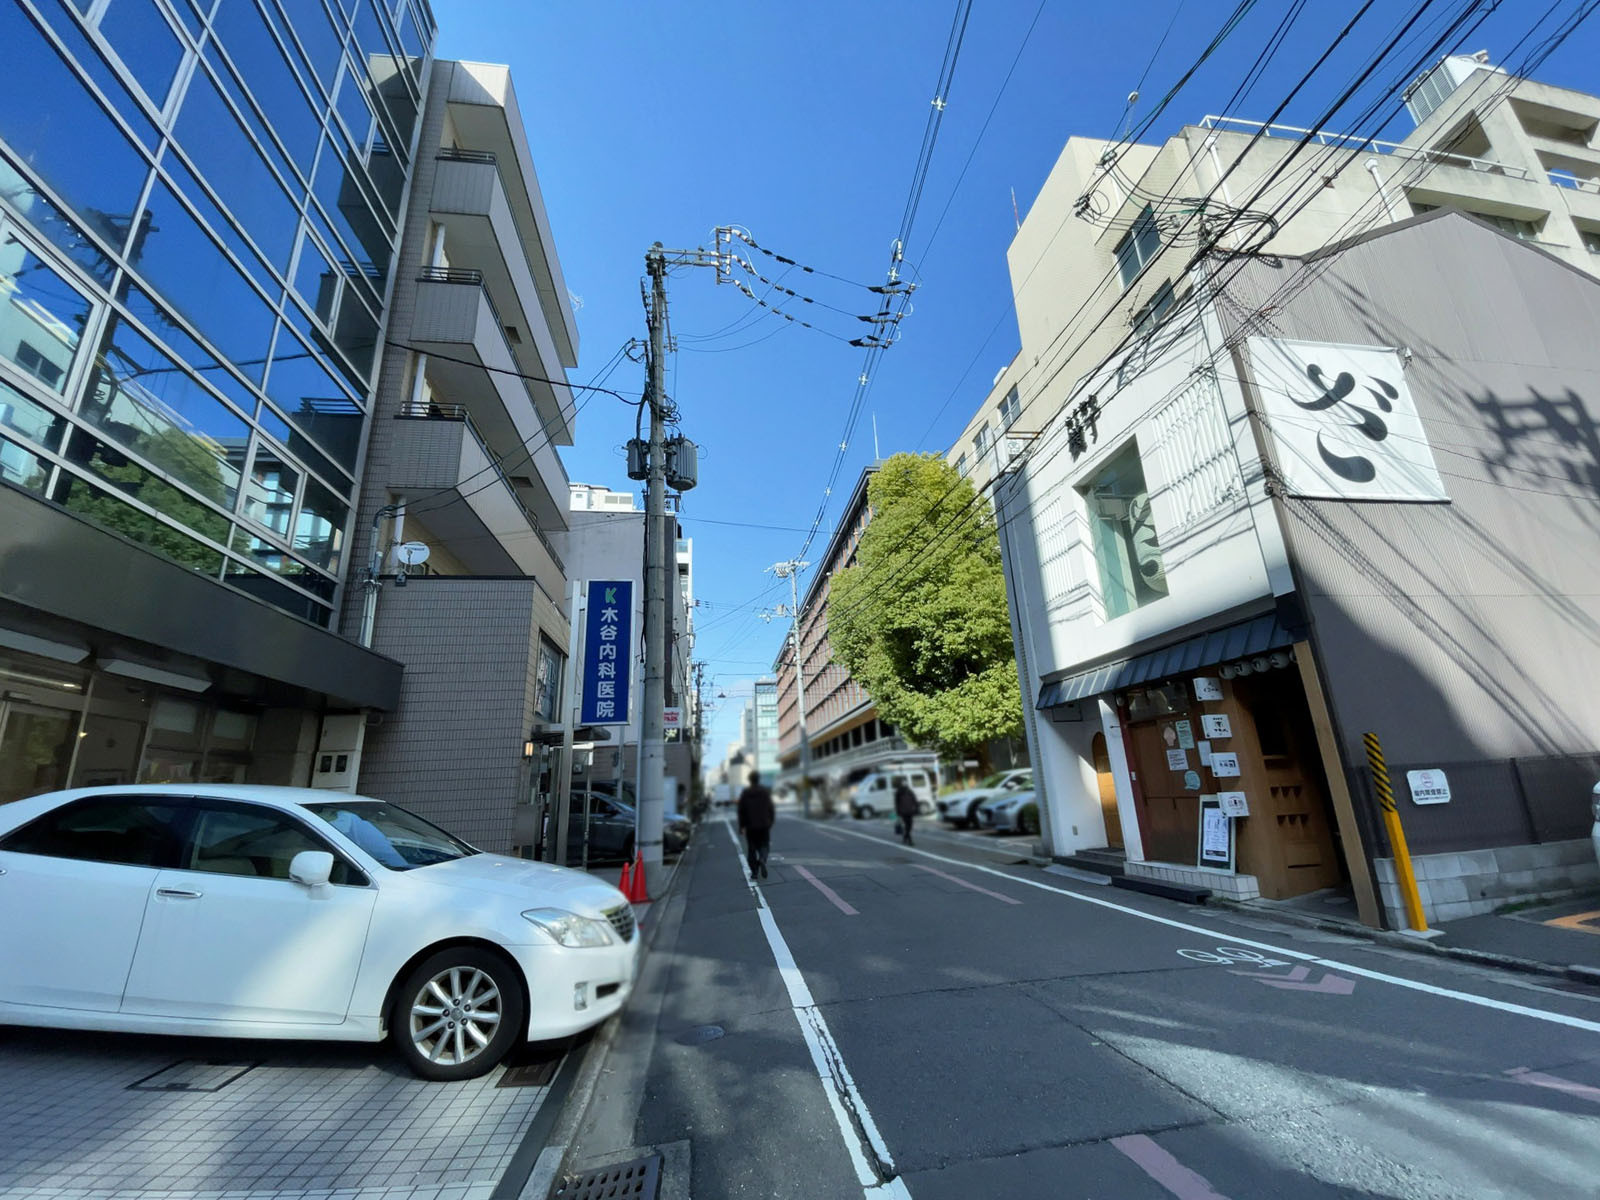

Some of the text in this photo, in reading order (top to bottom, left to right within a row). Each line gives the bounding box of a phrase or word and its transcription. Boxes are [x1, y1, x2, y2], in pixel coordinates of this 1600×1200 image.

[605, 587, 617, 604] K
[596, 607, 618, 718] 木谷内科医院
